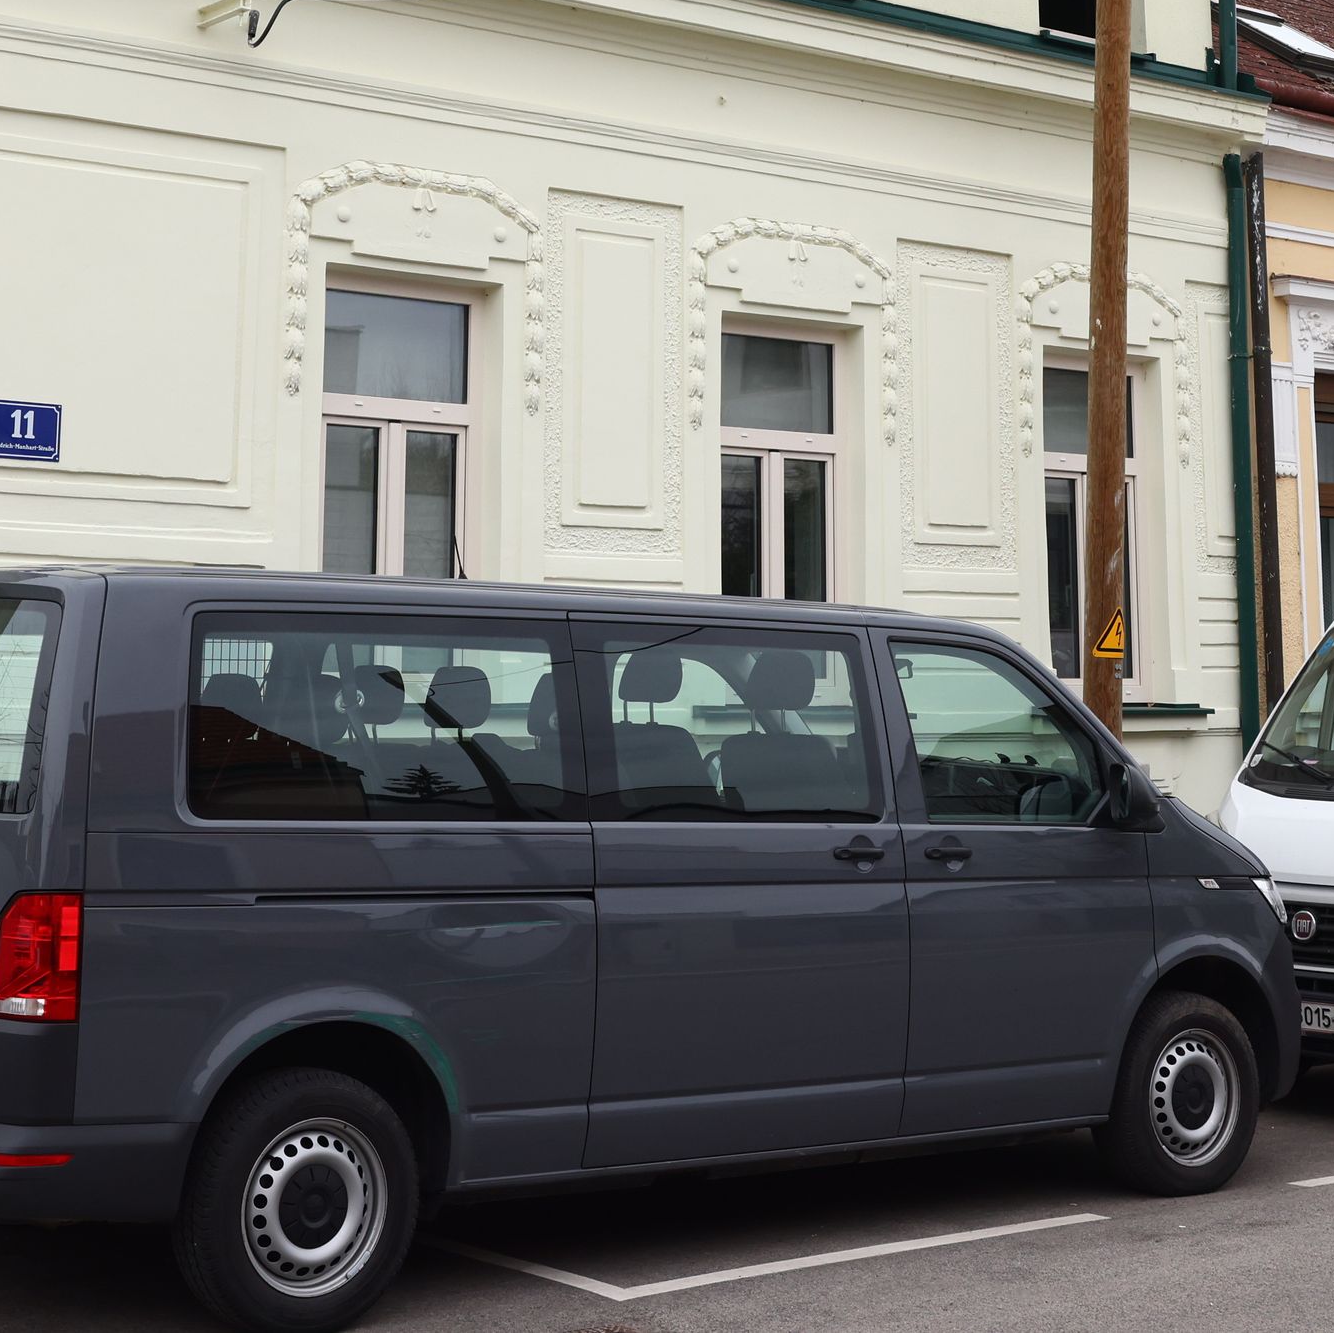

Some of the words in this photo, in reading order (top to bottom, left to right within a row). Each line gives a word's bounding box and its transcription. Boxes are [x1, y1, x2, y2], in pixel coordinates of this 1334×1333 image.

[10, 409, 36, 440] 11
[1296, 919, 1312, 933] FIAT
[1300, 1006, 1331, 1028] 015
